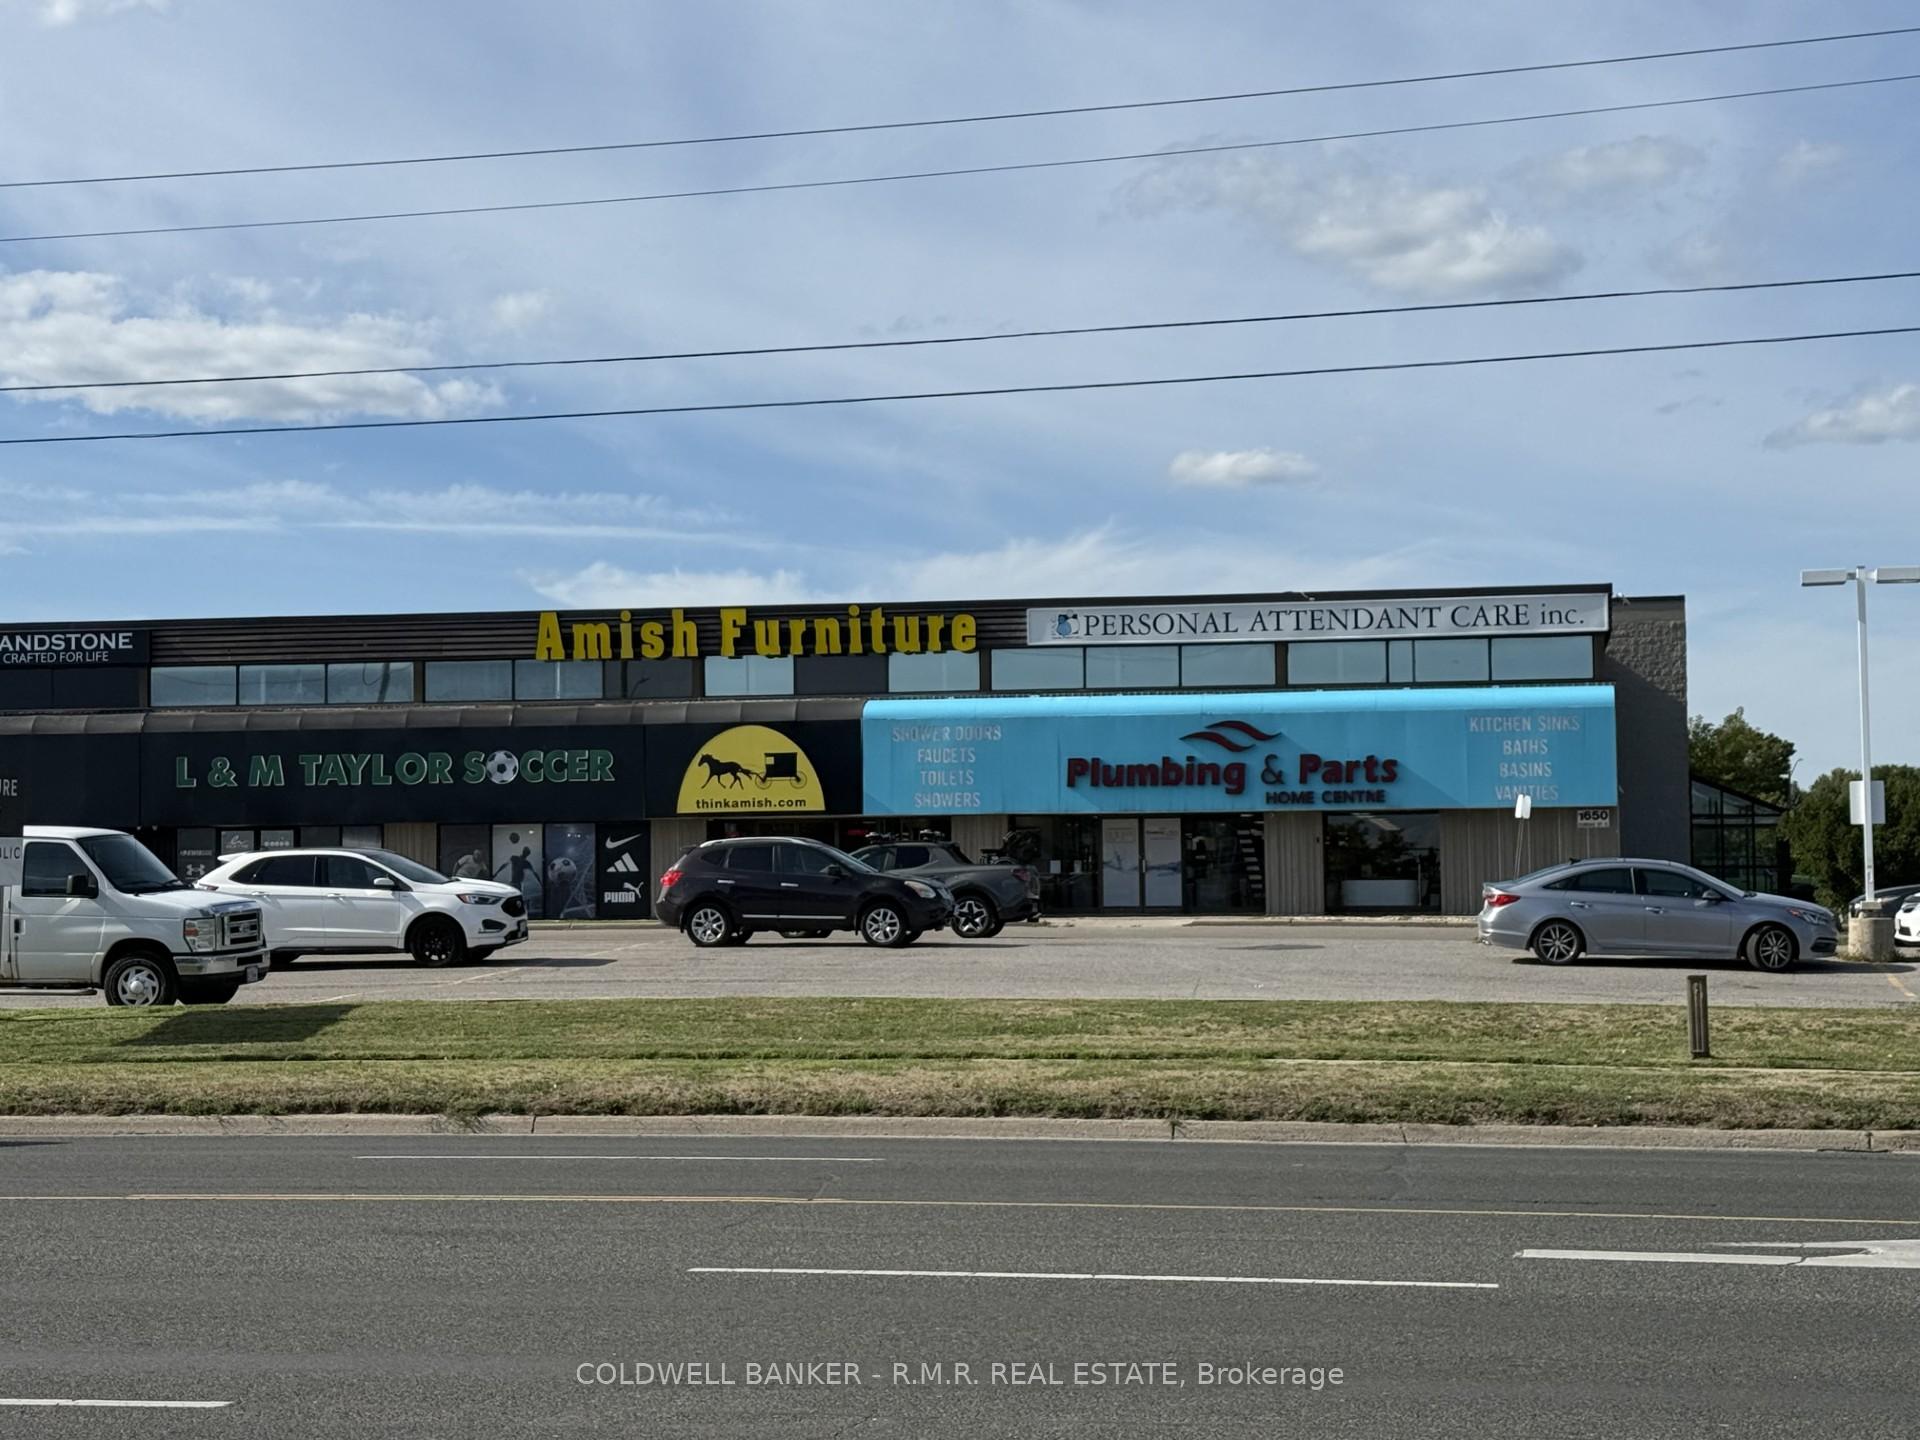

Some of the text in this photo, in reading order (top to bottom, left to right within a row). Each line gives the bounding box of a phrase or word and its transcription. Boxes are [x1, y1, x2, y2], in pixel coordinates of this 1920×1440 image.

[1084, 603, 1585, 637] PERSONAL ATTENDANT CARE inc.
[536, 604, 978, 661] Amish Furniture
[0, 632, 134, 651] ANDSTONE
[3, 650, 109, 664] CRAFTED FOR LIFE
[1469, 715, 1580, 733] KITCHEN SINKS
[892, 725, 1002, 742] SHOWER DOORS
[918, 747, 976, 763] FAUCETS
[1503, 739, 1549, 755] BATHS
[176, 756, 197, 788] L
[207, 756, 238, 788] &
[248, 754, 285, 787] M
[299, 753, 454, 786] TAYLOR
[920, 769, 974, 785] TOILETS
[1066, 753, 1399, 795] Plumbing & Parts
[1499, 762, 1553, 778] BASINS
[0, 779, 18, 797] RE
[696, 798, 807, 809] thinkamish.com
[913, 792, 981, 808] SHOWERS
[1265, 789, 1386, 806] HOME CENTRE
[1579, 810, 1608, 821] 1650
[0, 846, 21, 860] LIC
[604, 891, 636, 903] PUMA
